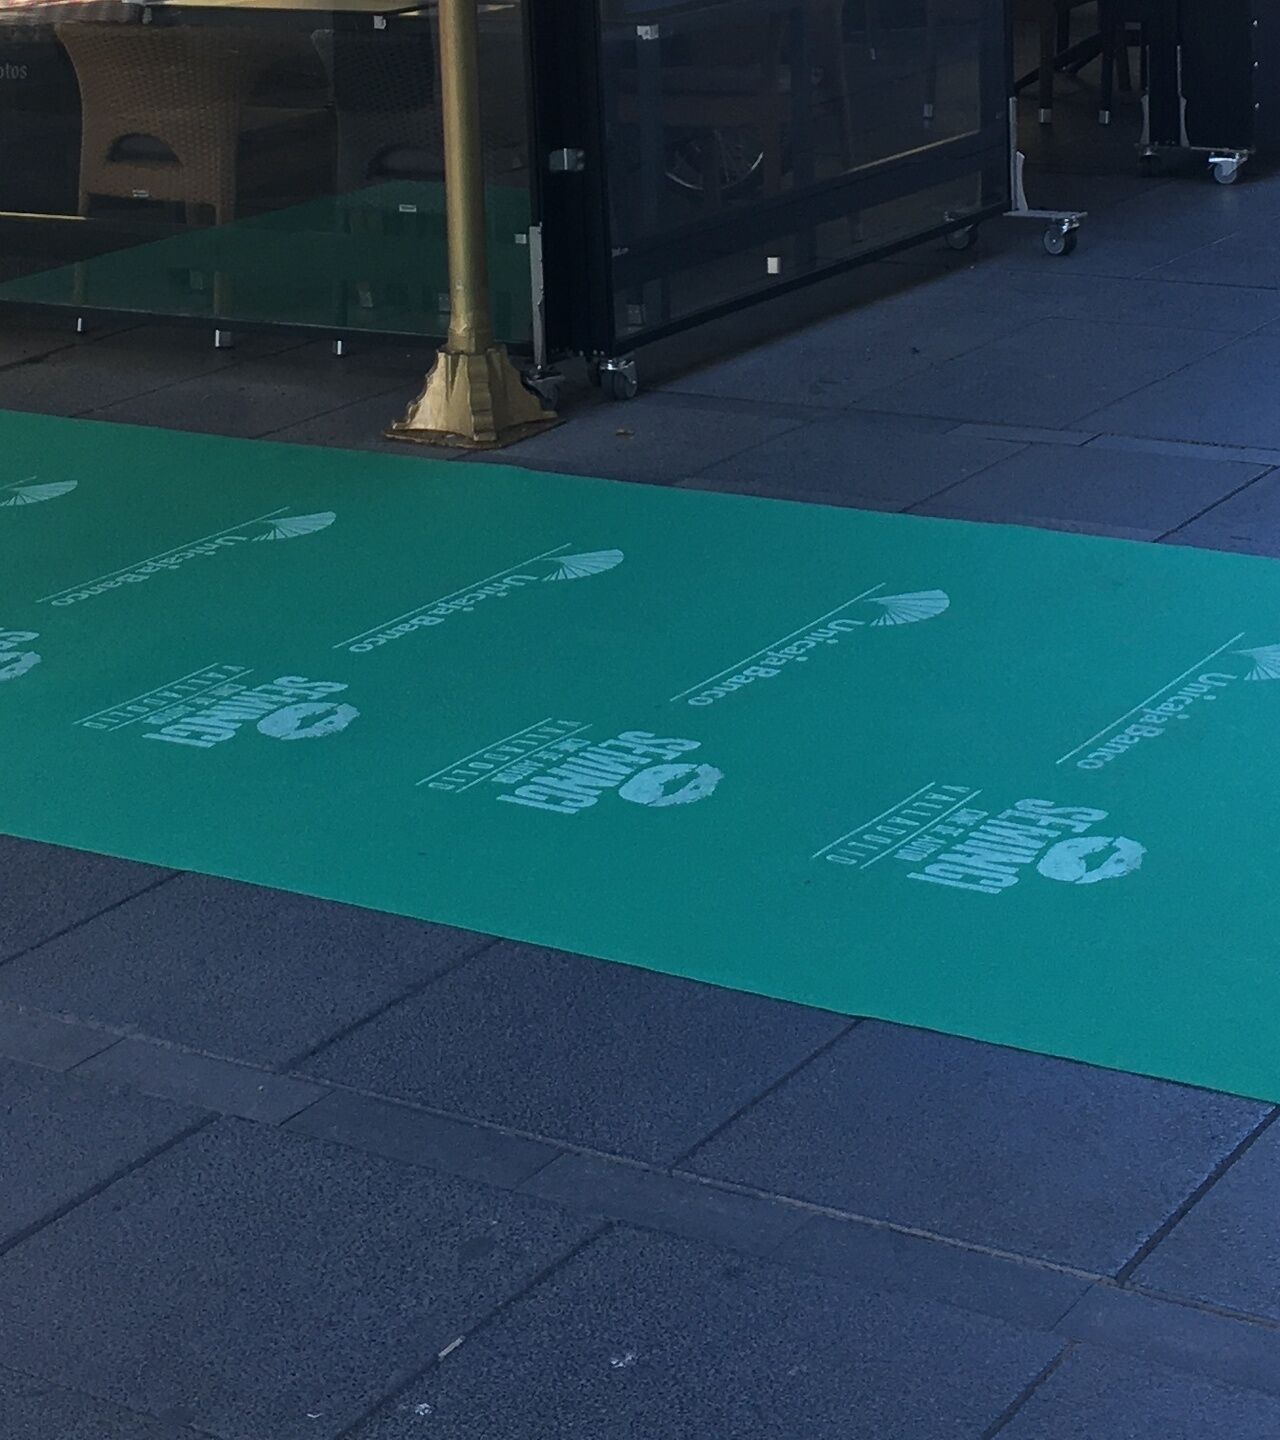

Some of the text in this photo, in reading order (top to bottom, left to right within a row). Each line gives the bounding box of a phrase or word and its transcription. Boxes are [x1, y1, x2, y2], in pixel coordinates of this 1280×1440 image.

[429, 574, 539, 615] Unicaja
[688, 618, 866, 706] Unicaja Banco
[141, 675, 349, 748] SEMINCI
[1076, 672, 1238, 770] Unicaja Banco
[427, 719, 583, 791] VALLADOLID
[496, 731, 702, 815] SEMINCI
[825, 784, 971, 865] VALLADOLID
[906, 797, 1110, 895] SEMINCI
